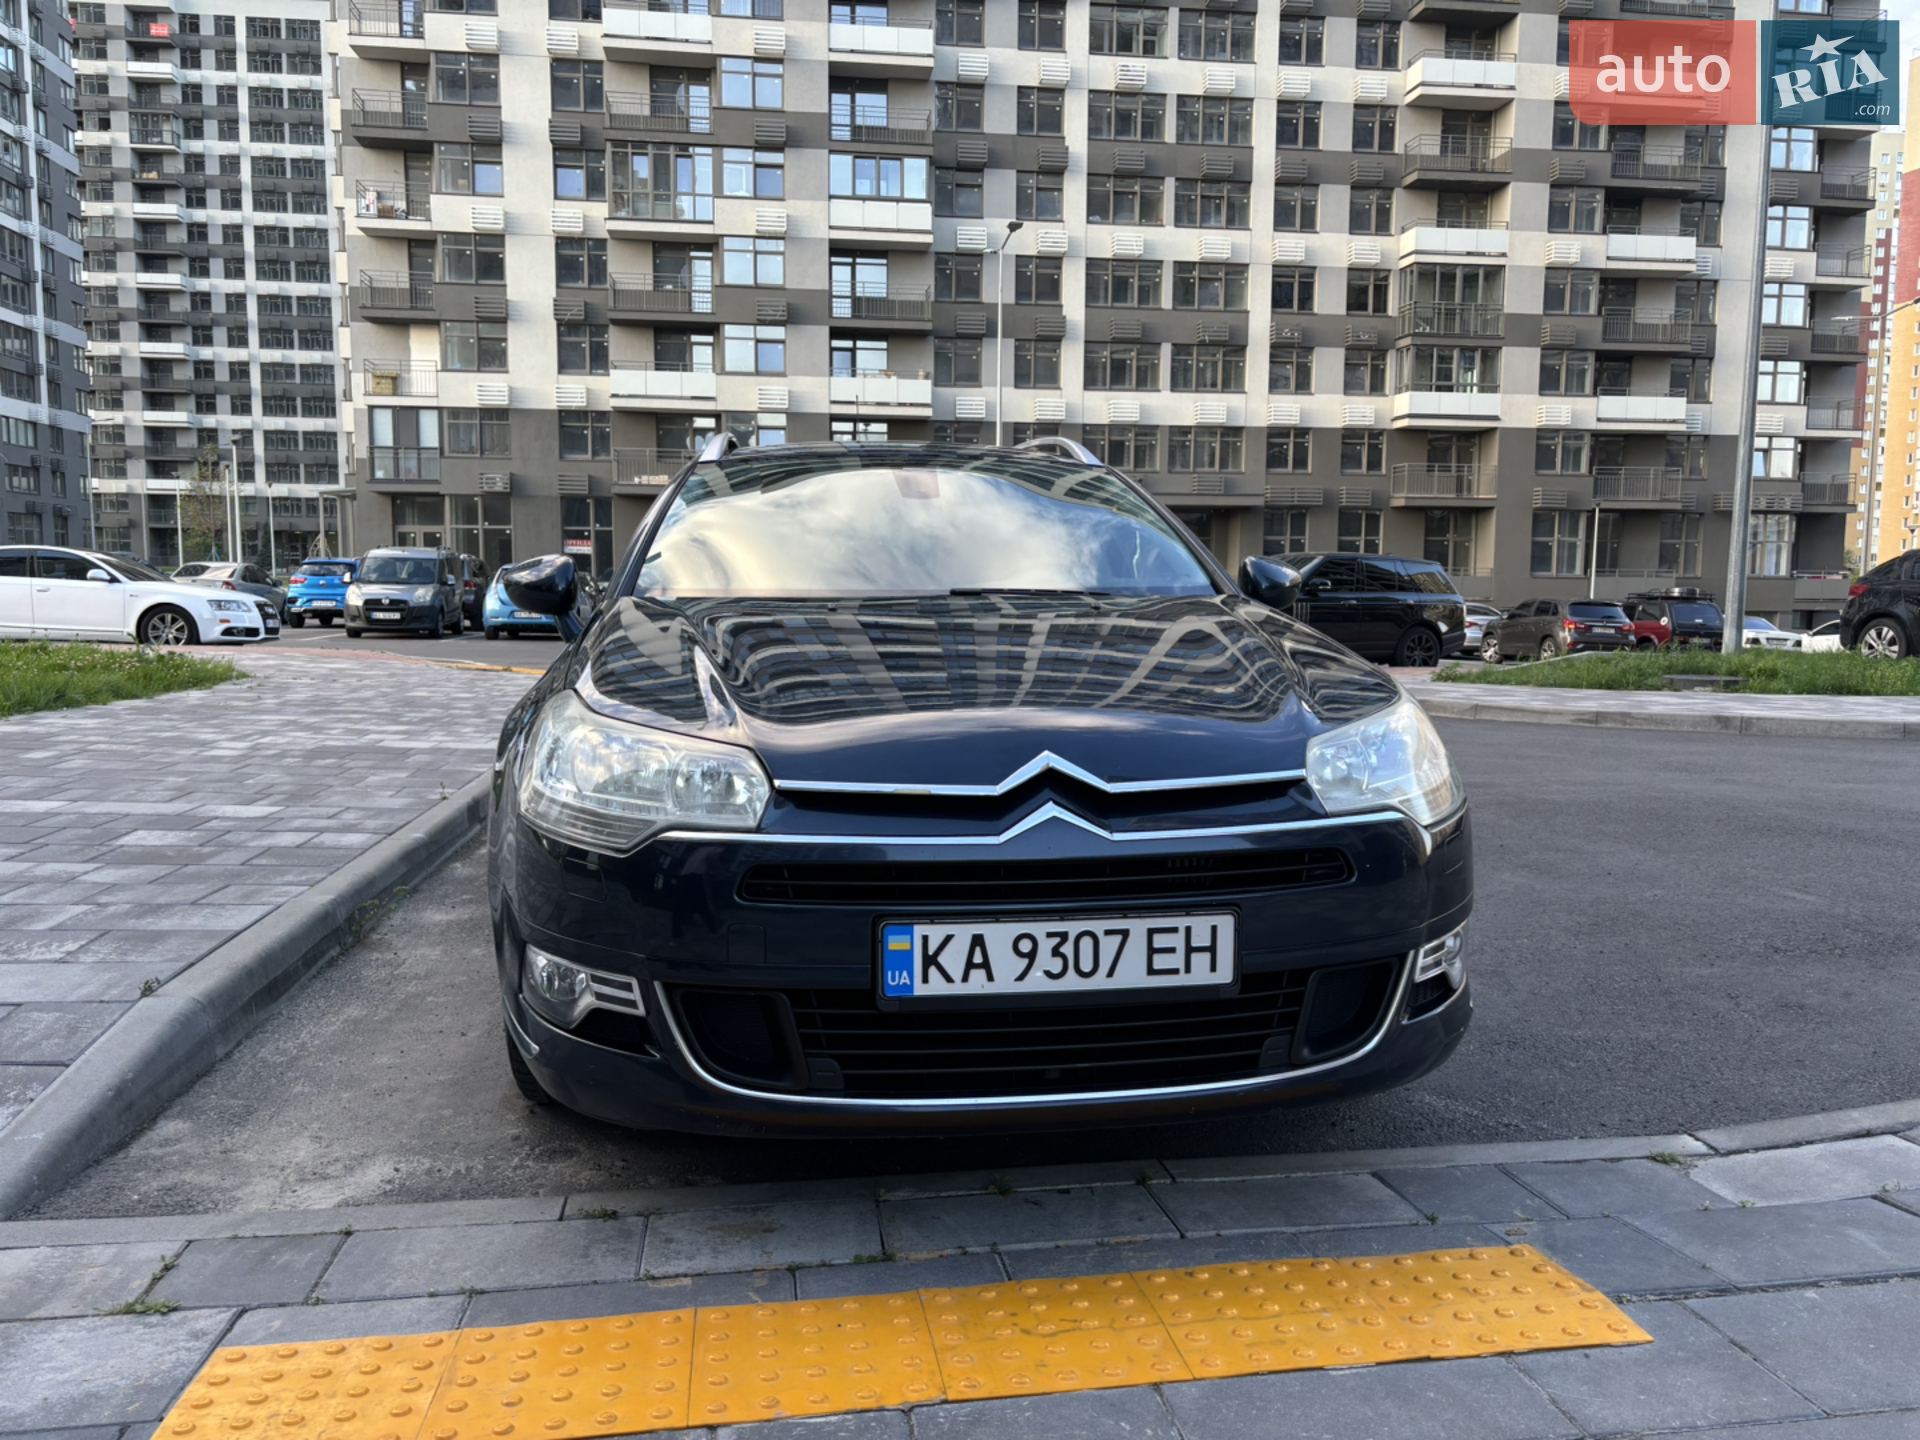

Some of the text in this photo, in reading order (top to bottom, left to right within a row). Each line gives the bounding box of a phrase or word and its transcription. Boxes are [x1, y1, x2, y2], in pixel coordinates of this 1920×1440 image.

[920, 924, 1218, 985] KA 9307 EH
[887, 970, 911, 986] UA
